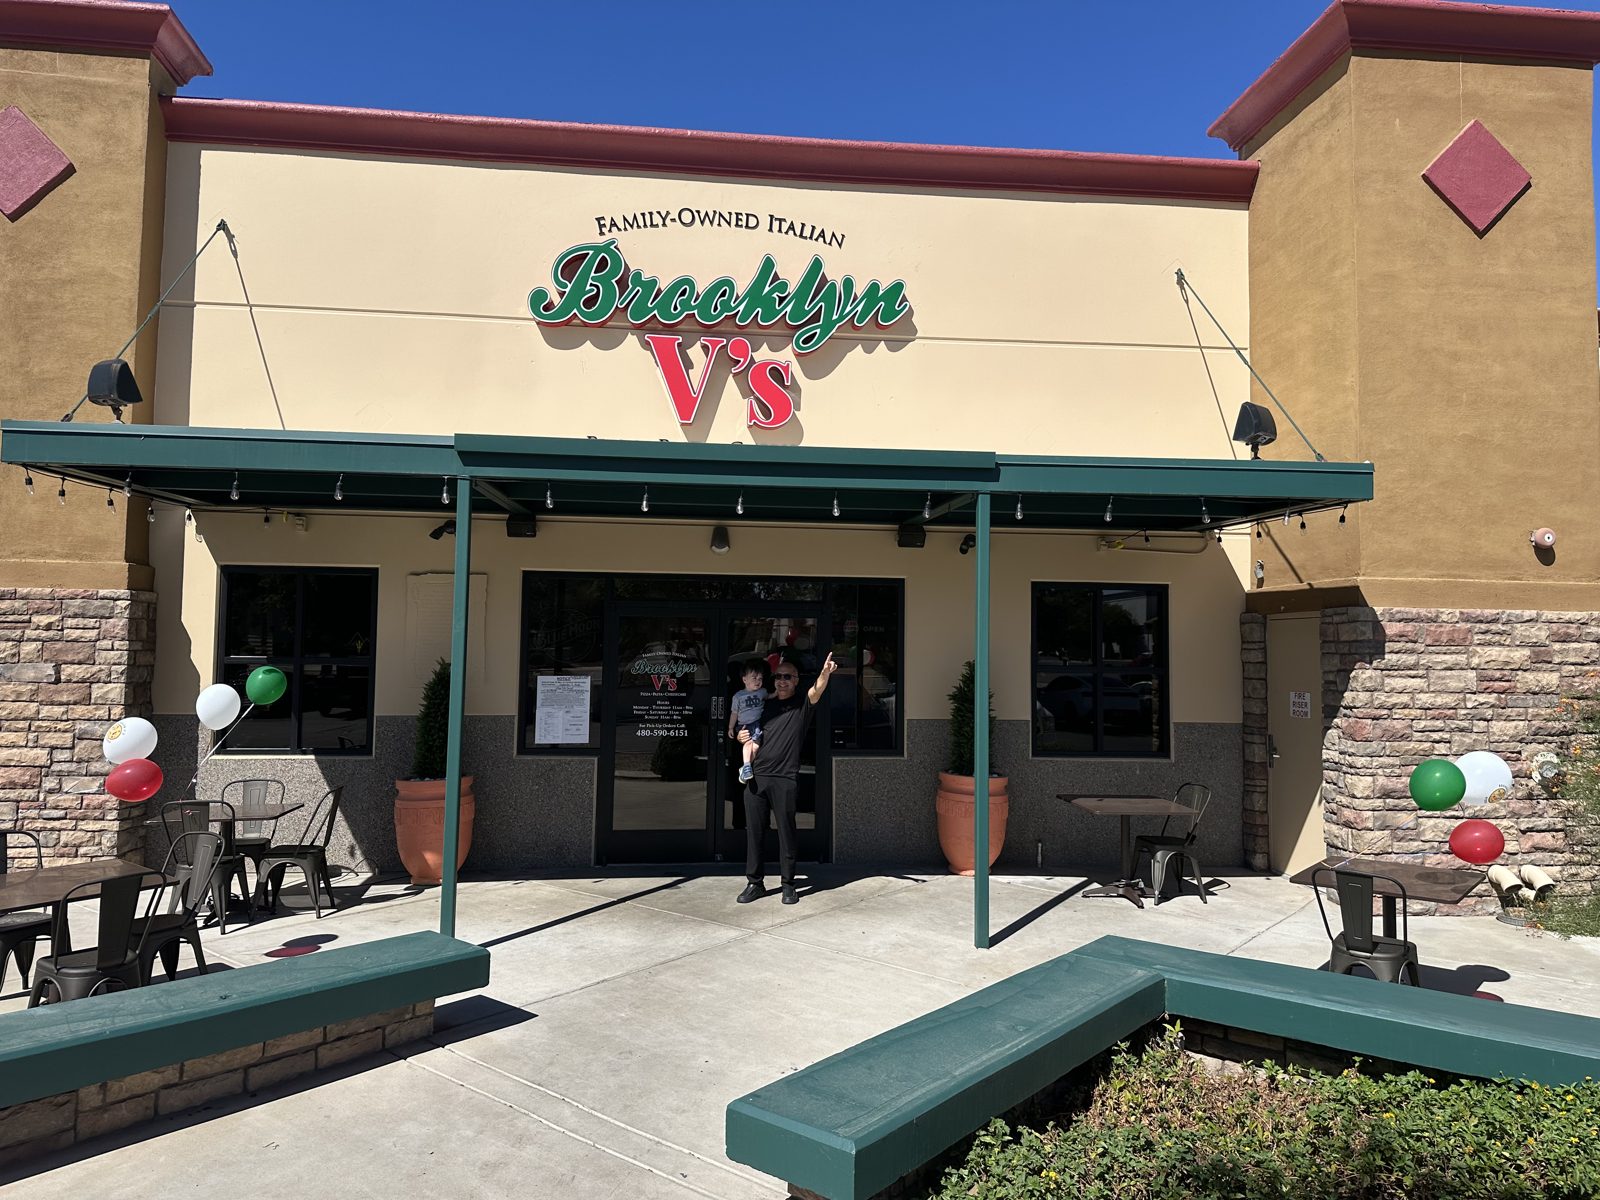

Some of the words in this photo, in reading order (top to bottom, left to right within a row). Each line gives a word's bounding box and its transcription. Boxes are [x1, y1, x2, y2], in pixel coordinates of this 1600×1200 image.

[594, 207, 760, 236] FAMILY-OWNED
[768, 214, 845, 249] ITALIAN
[528, 238, 910, 353] Brooklyn
[645, 333, 794, 429] V's
[631, 658, 698, 678] Brooklyn
[650, 674, 677, 691] V's
[1294, 692, 1306, 700] FIRE
[1292, 701, 1308, 709] RISER
[1292, 709, 1308, 718] ROOM
[636, 729, 688, 737] 480-590-6151
